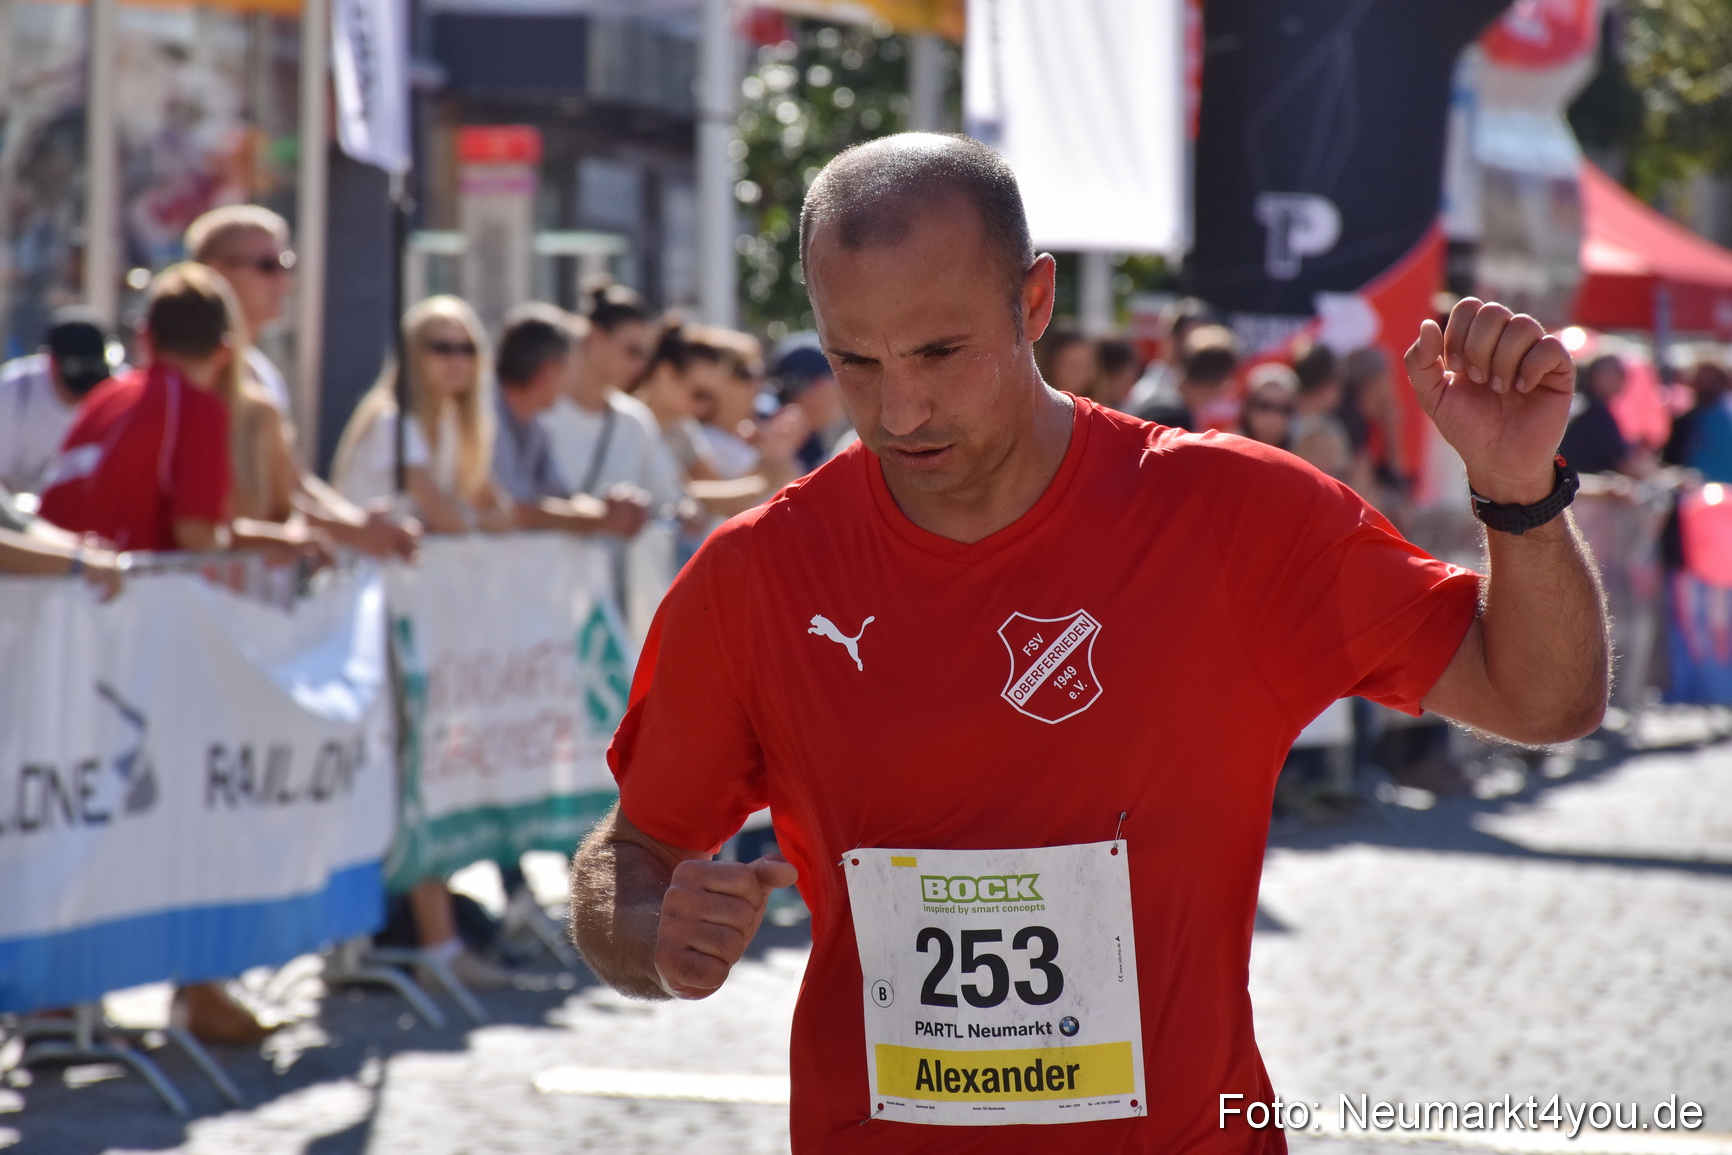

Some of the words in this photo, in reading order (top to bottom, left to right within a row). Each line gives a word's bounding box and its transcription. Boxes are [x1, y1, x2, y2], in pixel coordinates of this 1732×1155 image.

[1022, 632, 1044, 657] FSV
[1013, 619, 1091, 701] OBERFERRIEDEN
[1053, 665, 1077, 689] 1949
[1069, 680, 1088, 700] e.V.
[920, 873, 1044, 903] BOCK
[923, 904, 955, 914] inspired
[958, 904, 969, 915] by
[971, 905, 1000, 914] smart
[1002, 903, 1046, 913] concepts
[916, 926, 1064, 1008] 253
[879, 987, 887, 1001] B
[915, 1021, 964, 1039] PARTL
[968, 1021, 1053, 1039] Neumarkt
[915, 1058, 1080, 1093] Alexander
